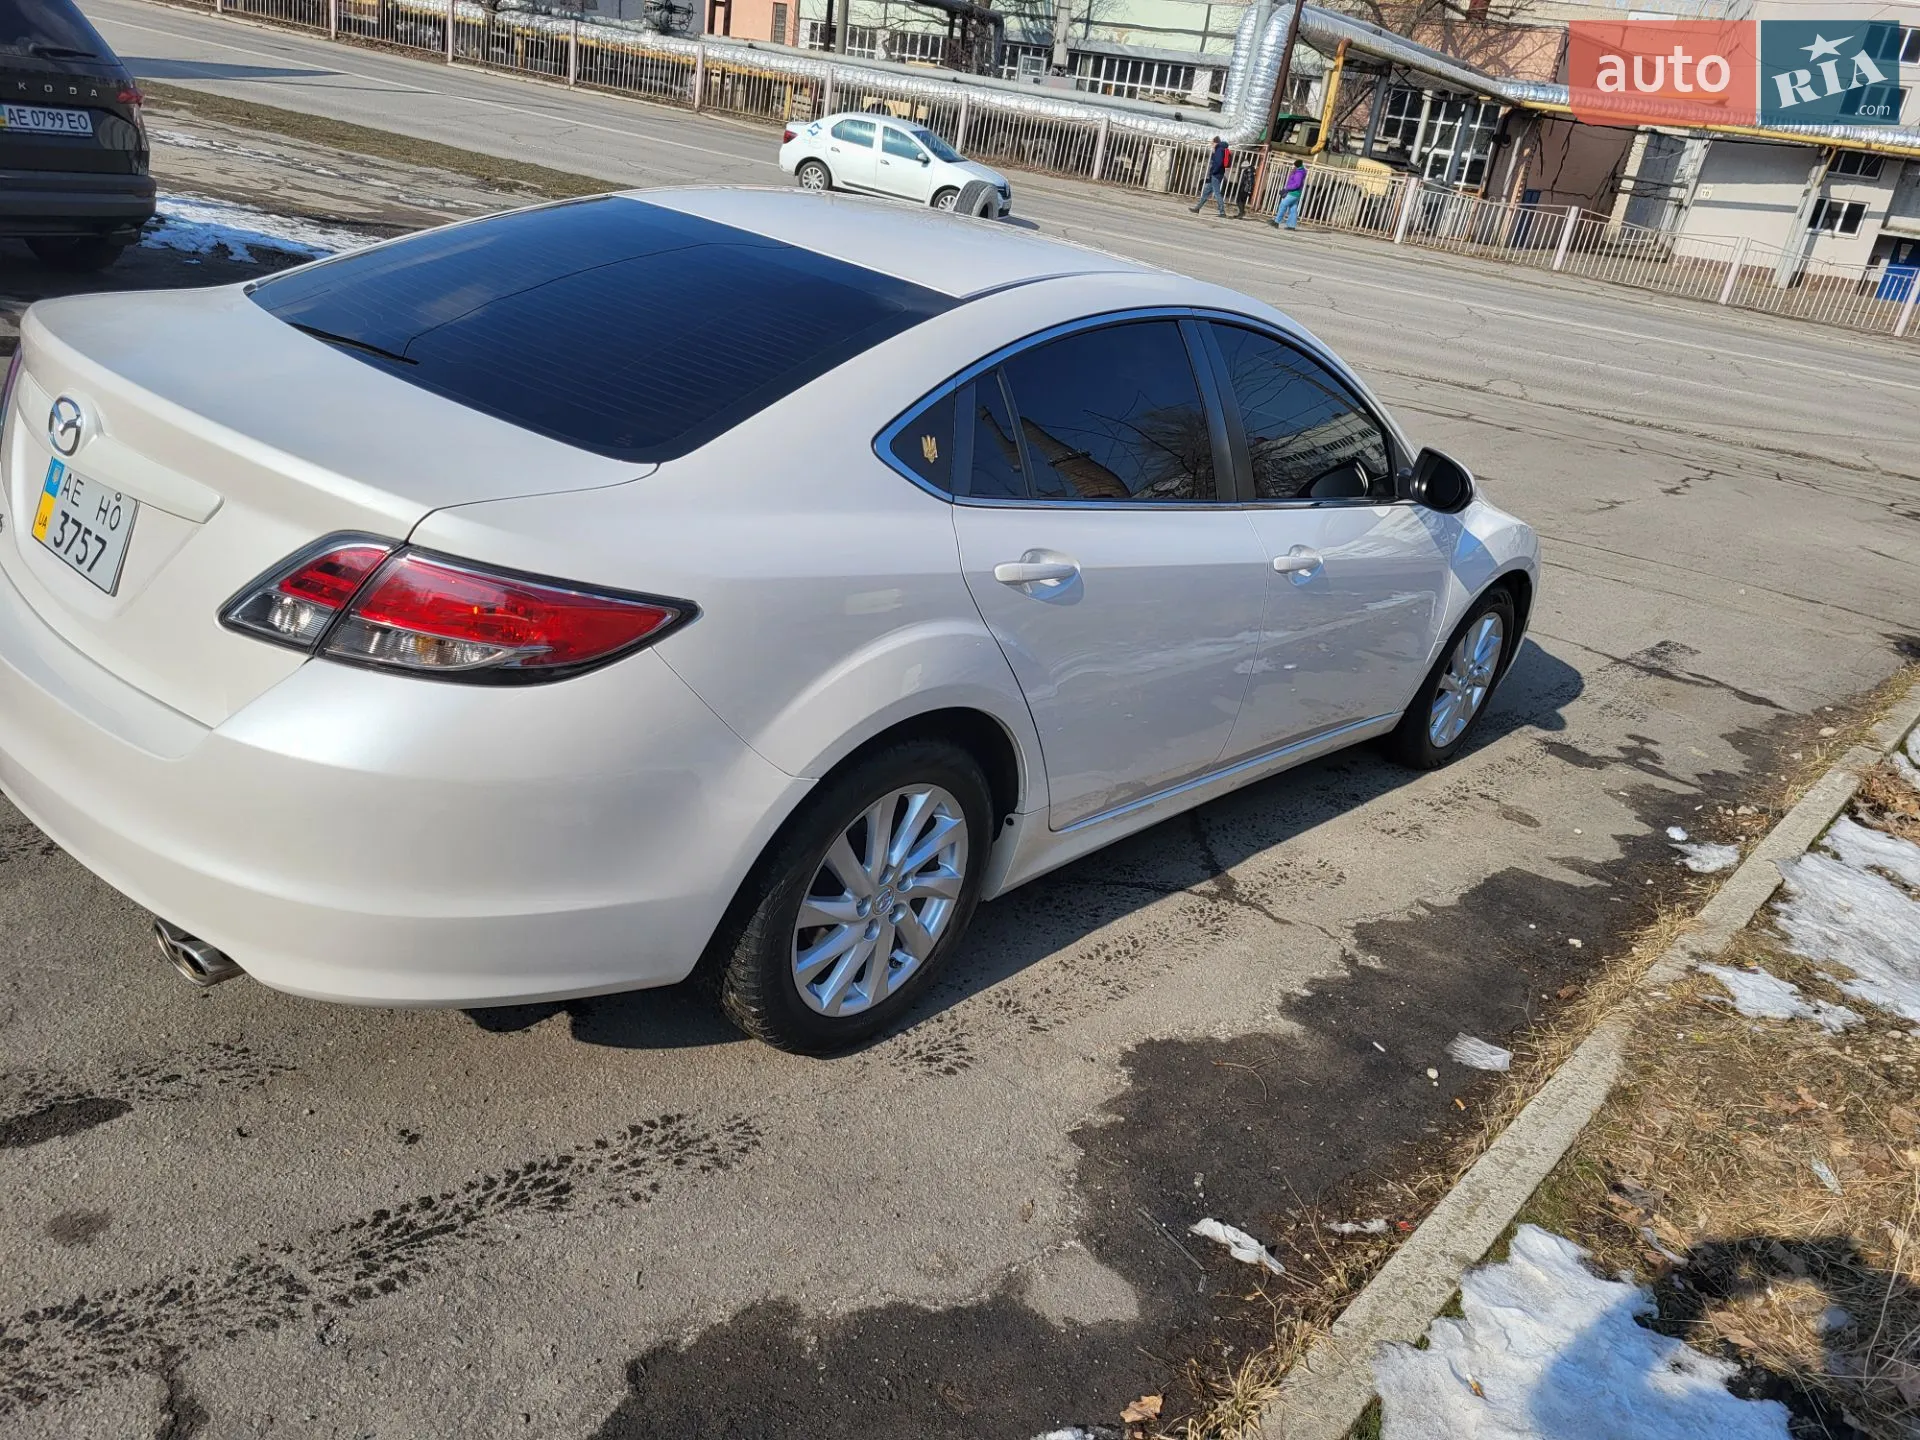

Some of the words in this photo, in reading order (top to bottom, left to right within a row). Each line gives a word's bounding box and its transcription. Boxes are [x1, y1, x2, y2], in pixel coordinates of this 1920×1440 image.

[8, 108, 30, 126] AE
[31, 110, 64, 128] 0799
[66, 113, 89, 130] EO
[38, 512, 48, 529] UA
[60, 472, 84, 508] AE
[95, 495, 122, 531] HO
[53, 510, 107, 573] 3757
